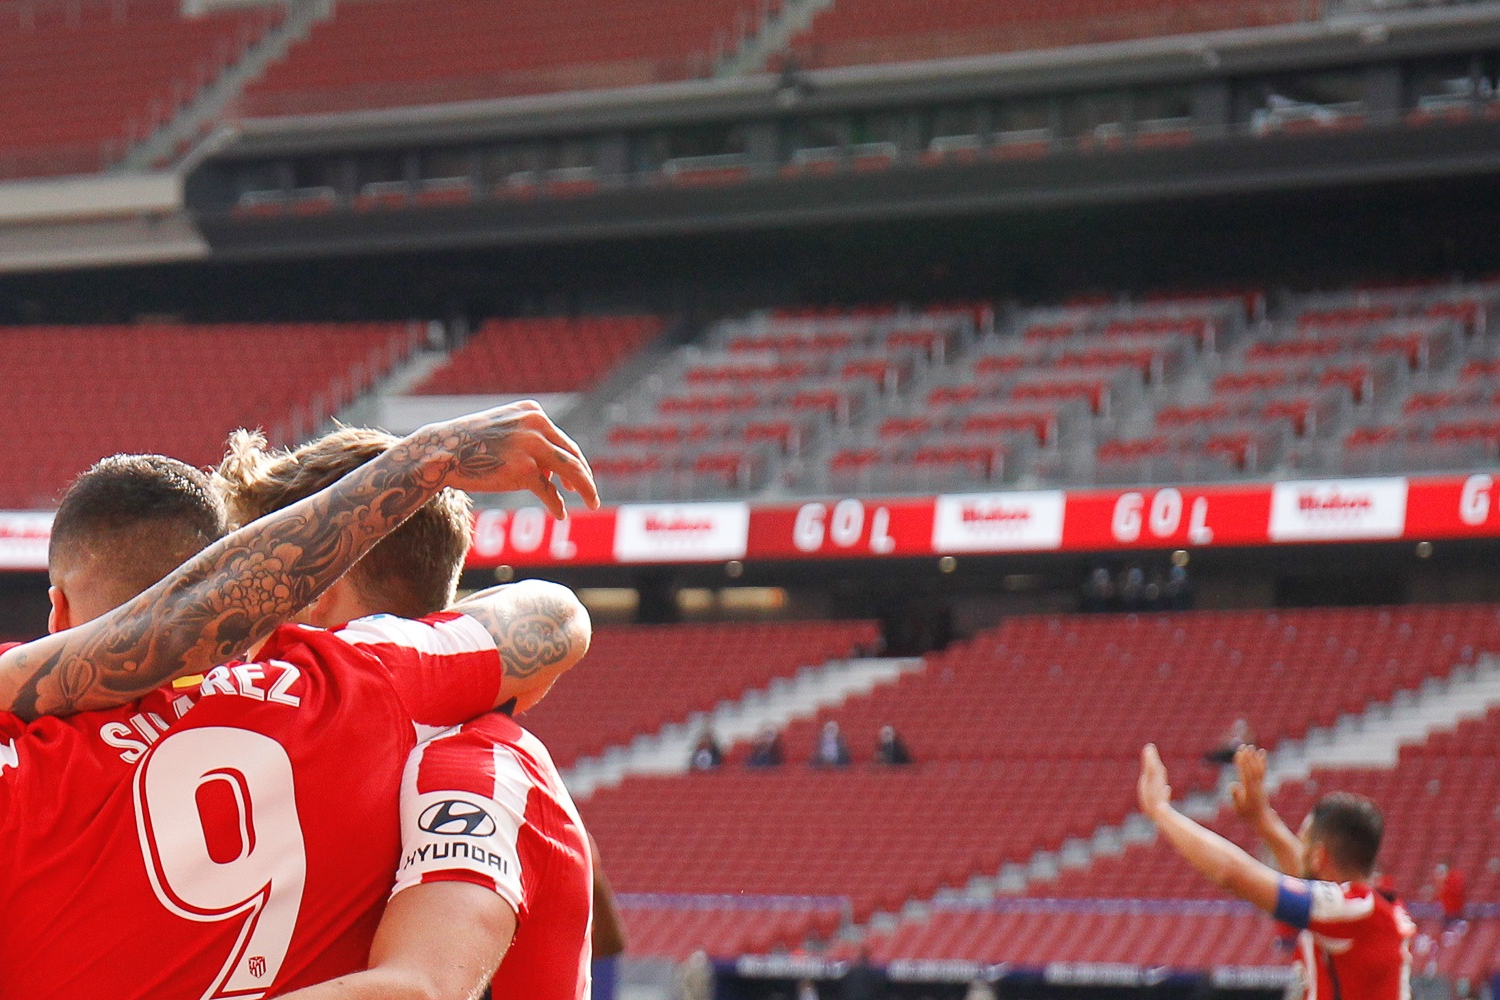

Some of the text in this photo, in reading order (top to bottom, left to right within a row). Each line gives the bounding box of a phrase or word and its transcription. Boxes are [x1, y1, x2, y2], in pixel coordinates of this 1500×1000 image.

[474, 507, 577, 559] GOL
[793, 500, 895, 554] GOL
[1111, 489, 1213, 543] GOL
[403, 841, 508, 875] HYUNDAI
